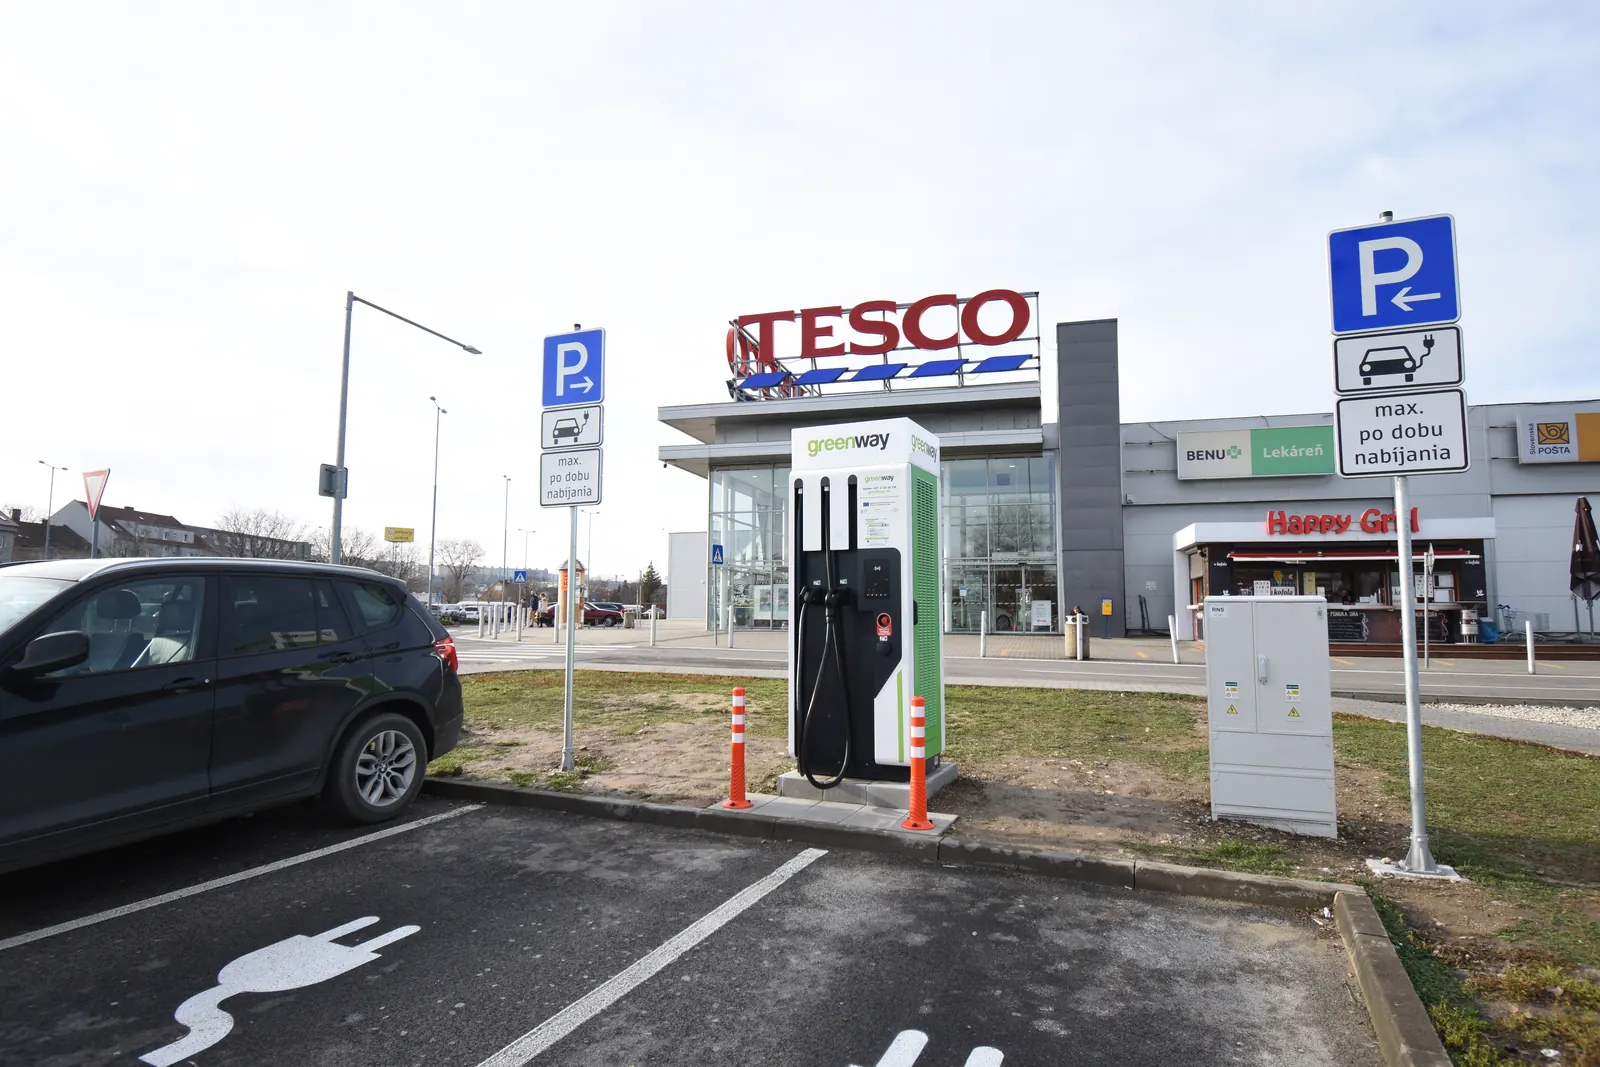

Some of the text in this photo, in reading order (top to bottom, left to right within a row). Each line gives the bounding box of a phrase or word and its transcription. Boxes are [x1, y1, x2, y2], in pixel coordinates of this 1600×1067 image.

[1358, 236, 1424, 317] P
[738, 289, 1031, 363] TESCO
[555, 341, 589, 397] P
[1375, 402, 1424, 418] max.
[1360, 422, 1443, 445] po dobu
[807, 432, 891, 457] greenway
[911, 433, 938, 463] greenway
[1186, 443, 1324, 461] BENU Lekáreň
[1538, 445, 1571, 455] POŠTA
[558, 455, 582, 467] max.
[1355, 444, 1451, 466] nabíjania
[550, 470, 590, 486] po dobu
[864, 475, 895, 484] greenway
[547, 485, 592, 501] nabíjania
[1266, 507, 1420, 535] Happy Grl
[1273, 588, 1293, 596] kofola
